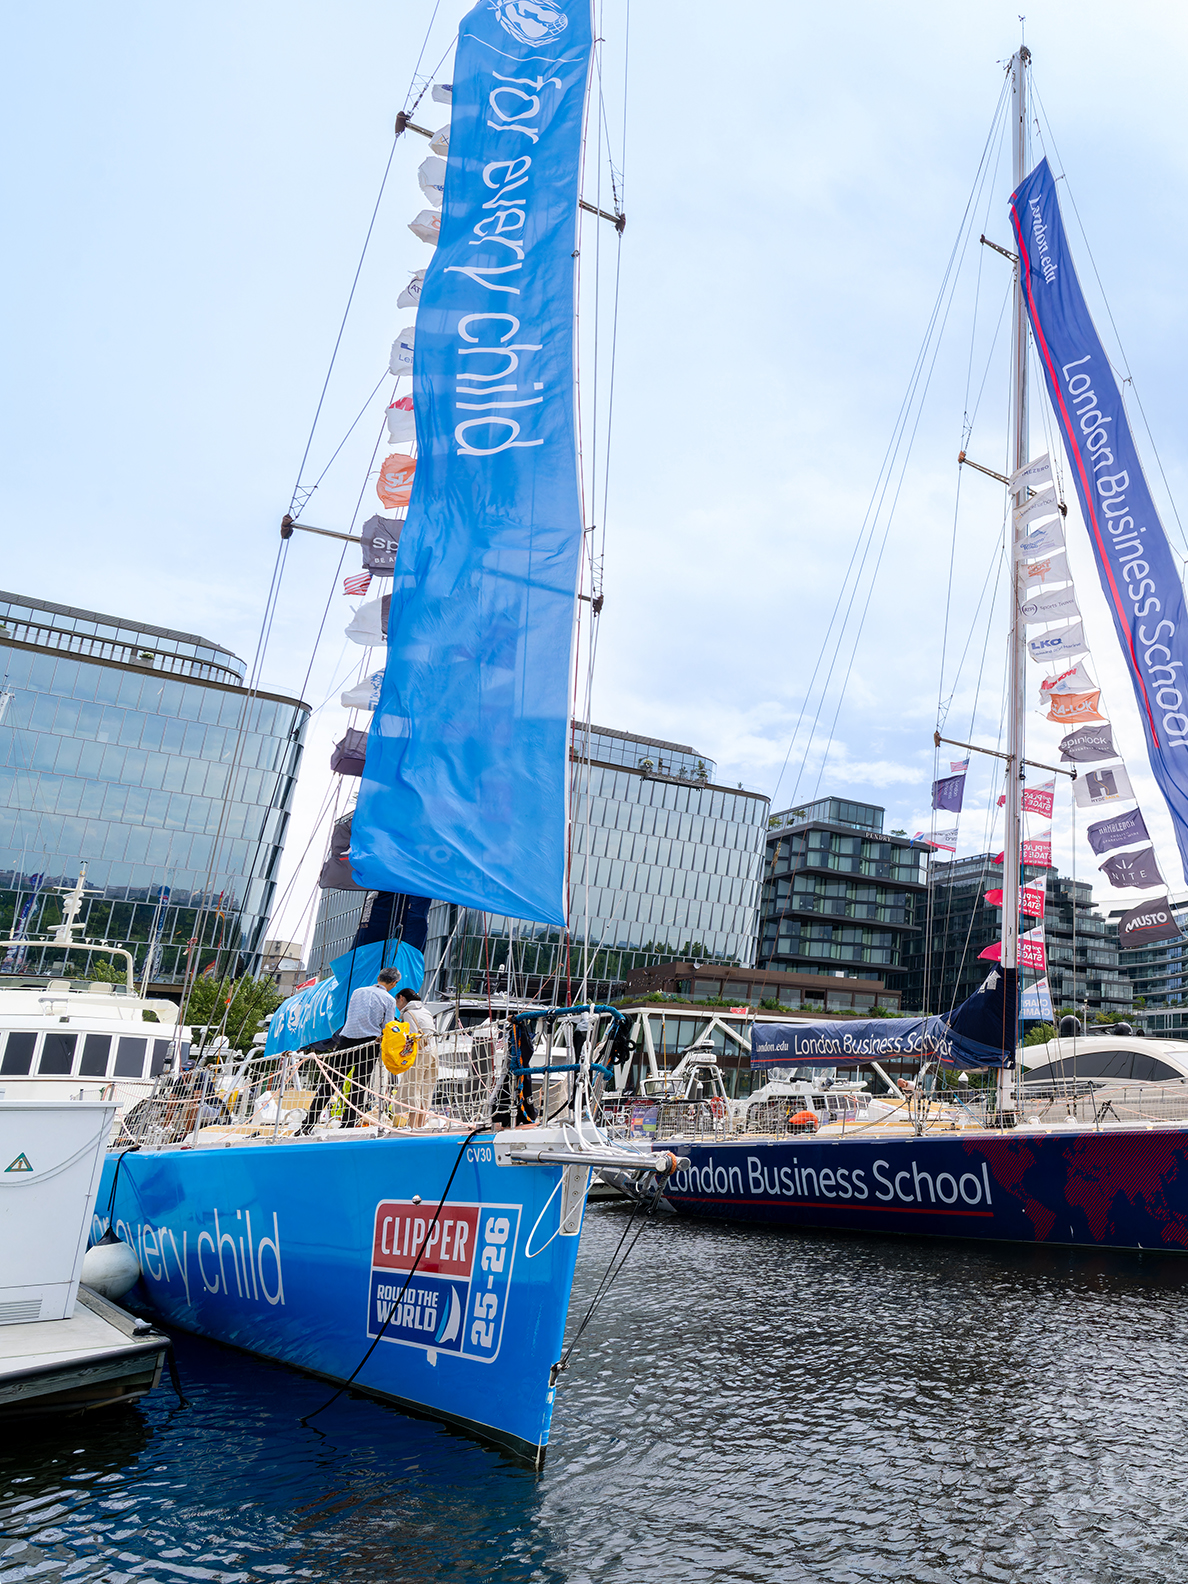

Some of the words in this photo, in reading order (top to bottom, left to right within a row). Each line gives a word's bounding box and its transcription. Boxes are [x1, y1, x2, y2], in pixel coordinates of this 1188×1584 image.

[487, 69, 562, 145] for
[443, 154, 532, 296] every
[454, 311, 545, 458] child
[1062, 354, 1115, 474] London
[1096, 469, 1162, 618] Business
[1030, 637, 1063, 650] LKQ
[1060, 736, 1108, 749] spinlock
[1124, 911, 1168, 933] MUSTO
[794, 1034, 840, 1055] London
[842, 1033, 904, 1055] Business
[466, 1147, 492, 1163] CV30
[747, 1155, 869, 1200] Business
[872, 1159, 992, 1205] School
[197, 1207, 286, 1306] child
[380, 1215, 470, 1263] CLIPPER
[376, 1284, 416, 1305] ROUND
[417, 1289, 440, 1309] THE
[470, 1216, 511, 1349] 25-26
[376, 1299, 438, 1333] WORLD
